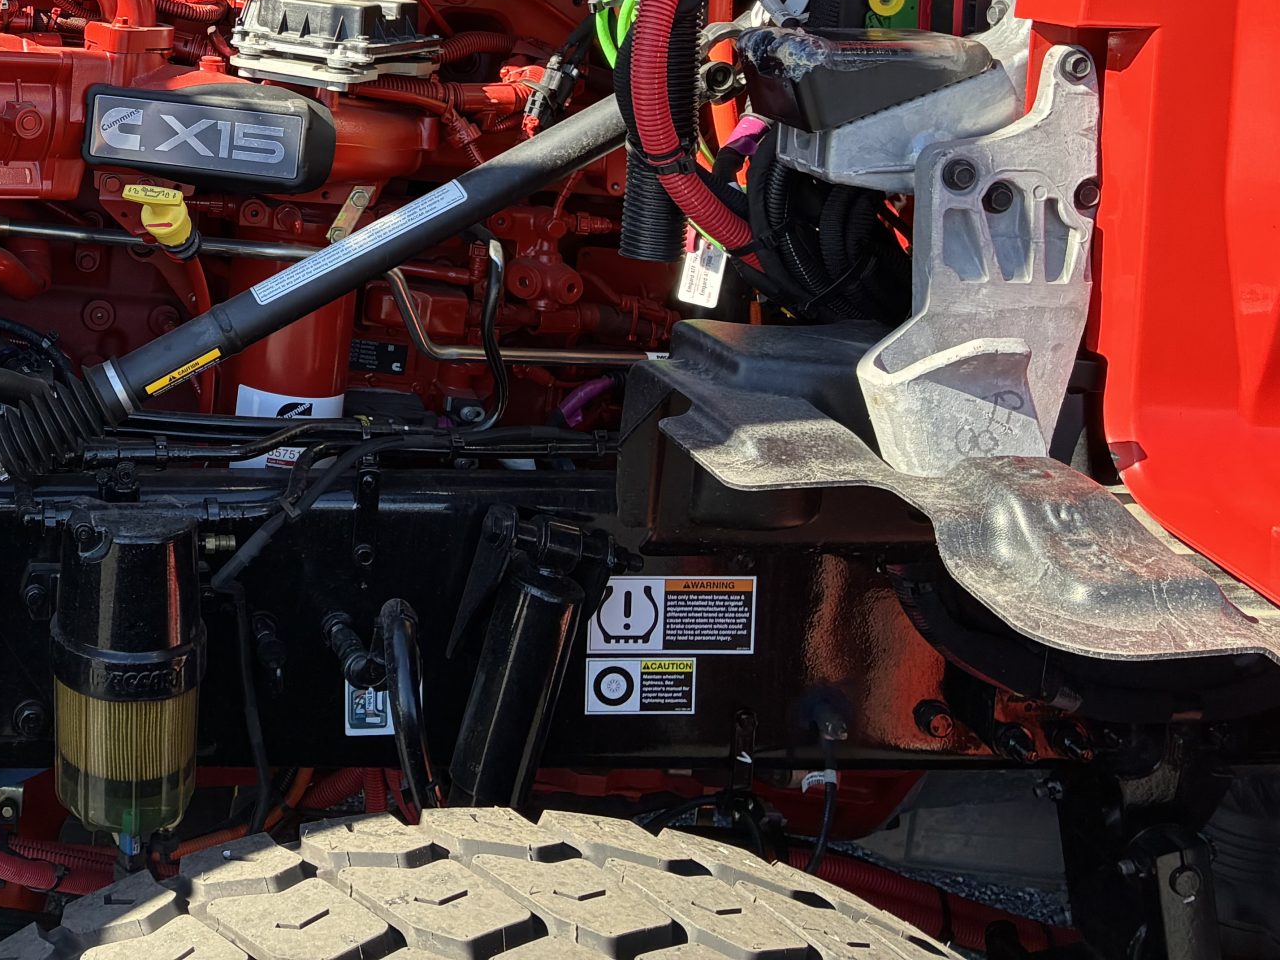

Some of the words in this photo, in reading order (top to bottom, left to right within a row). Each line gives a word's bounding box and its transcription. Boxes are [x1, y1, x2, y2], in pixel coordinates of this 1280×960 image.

[101, 108, 140, 132] Cummins
[154, 114, 285, 164] X15
[177, 360, 200, 376] CAUTION
[691, 581, 735, 589] WARNING
[651, 662, 691, 670] CAUTION
